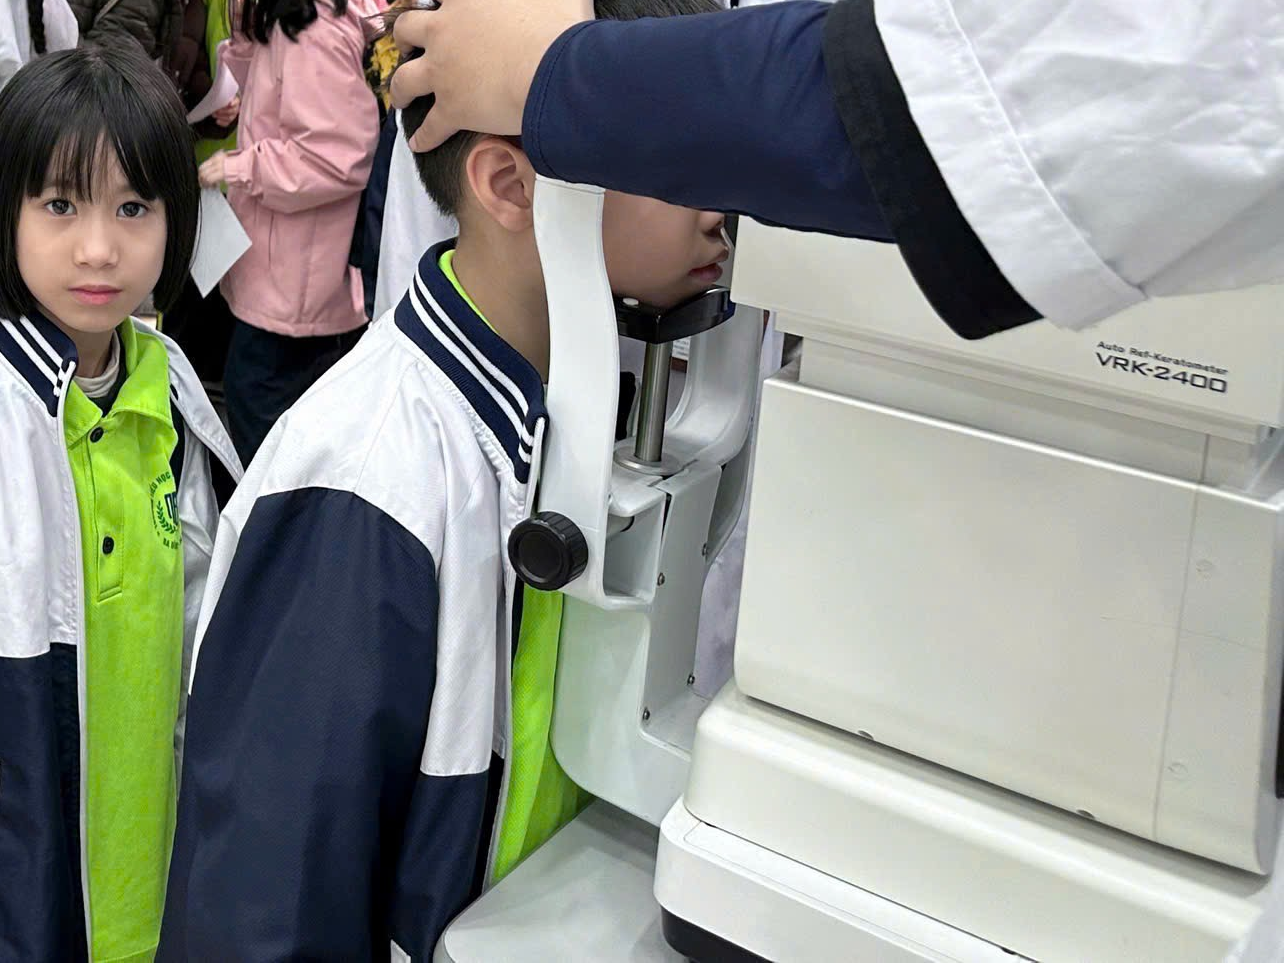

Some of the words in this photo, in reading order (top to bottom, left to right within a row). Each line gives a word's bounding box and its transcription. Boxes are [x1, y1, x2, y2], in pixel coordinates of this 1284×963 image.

[1095, 352, 1228, 394] VRK-2400
[1097, 341, 1126, 353] Auto
[1129, 347, 1228, 375] Ref-Keratometer
